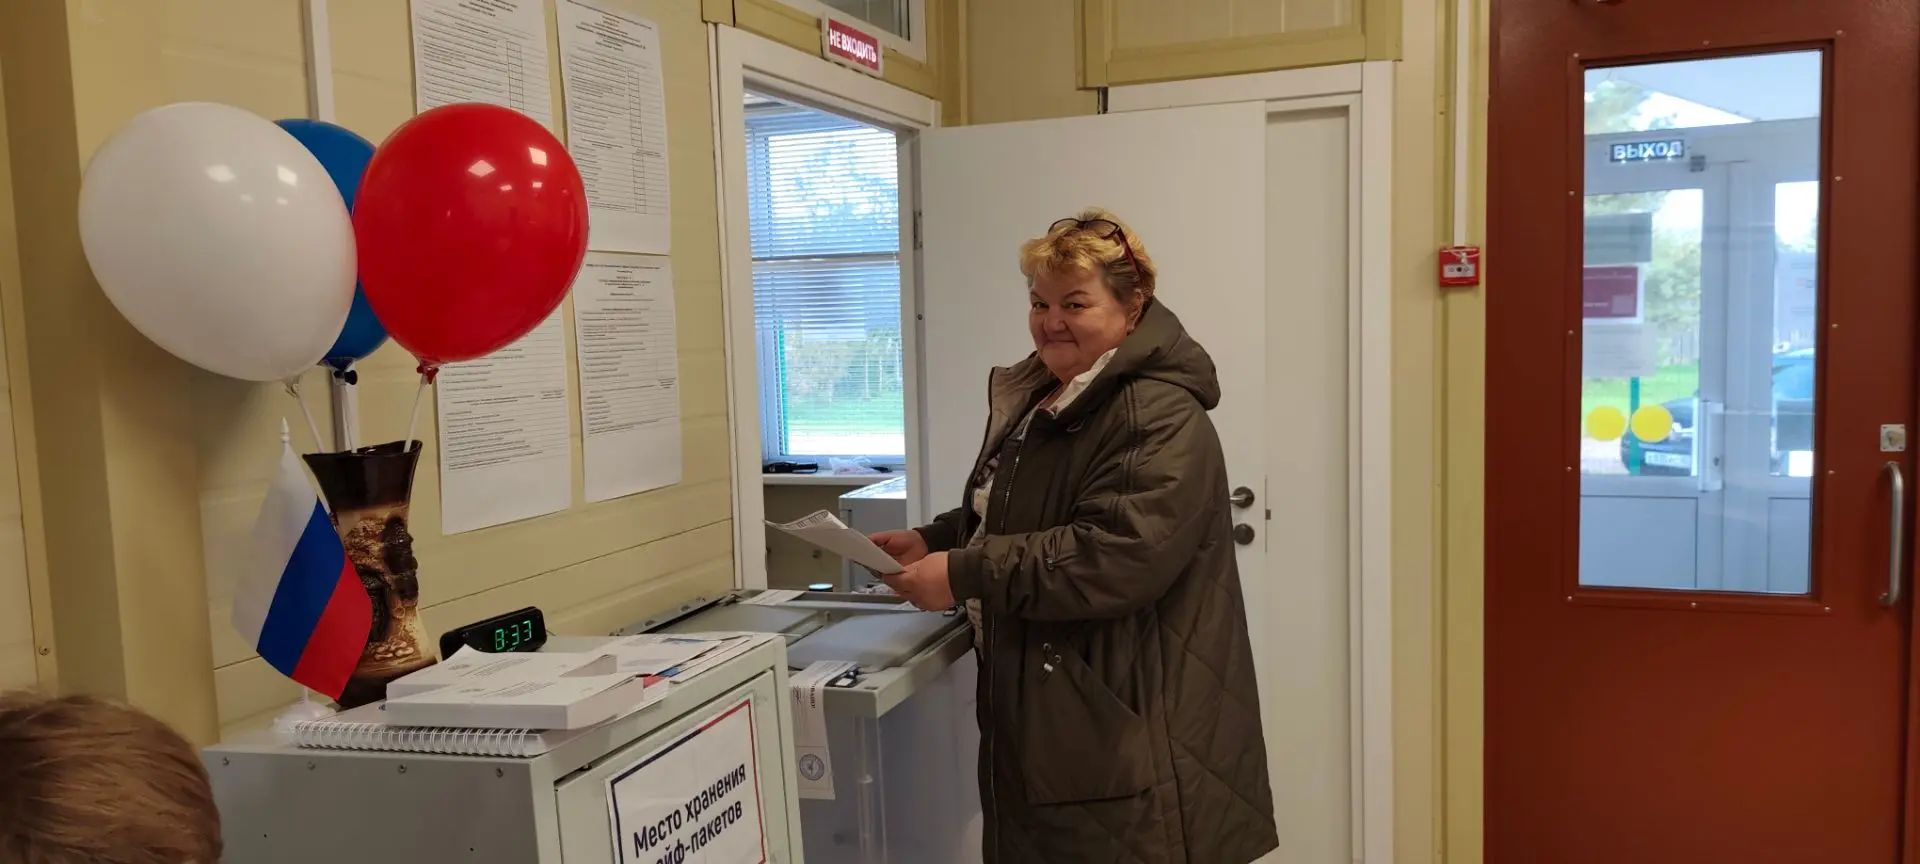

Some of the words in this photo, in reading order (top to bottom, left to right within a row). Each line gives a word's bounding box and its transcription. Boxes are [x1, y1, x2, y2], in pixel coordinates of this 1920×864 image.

[829, 28, 841, 49] НЕ
[841, 33, 877, 63] ВХОДИТЬ
[1613, 141, 1682, 160] ВЫХОД
[495, 620, 532, 651] 8:33
[633, 809, 682, 858] Место
[684, 763, 747, 823] хранения
[655, 800, 743, 864] йф-пакетов
